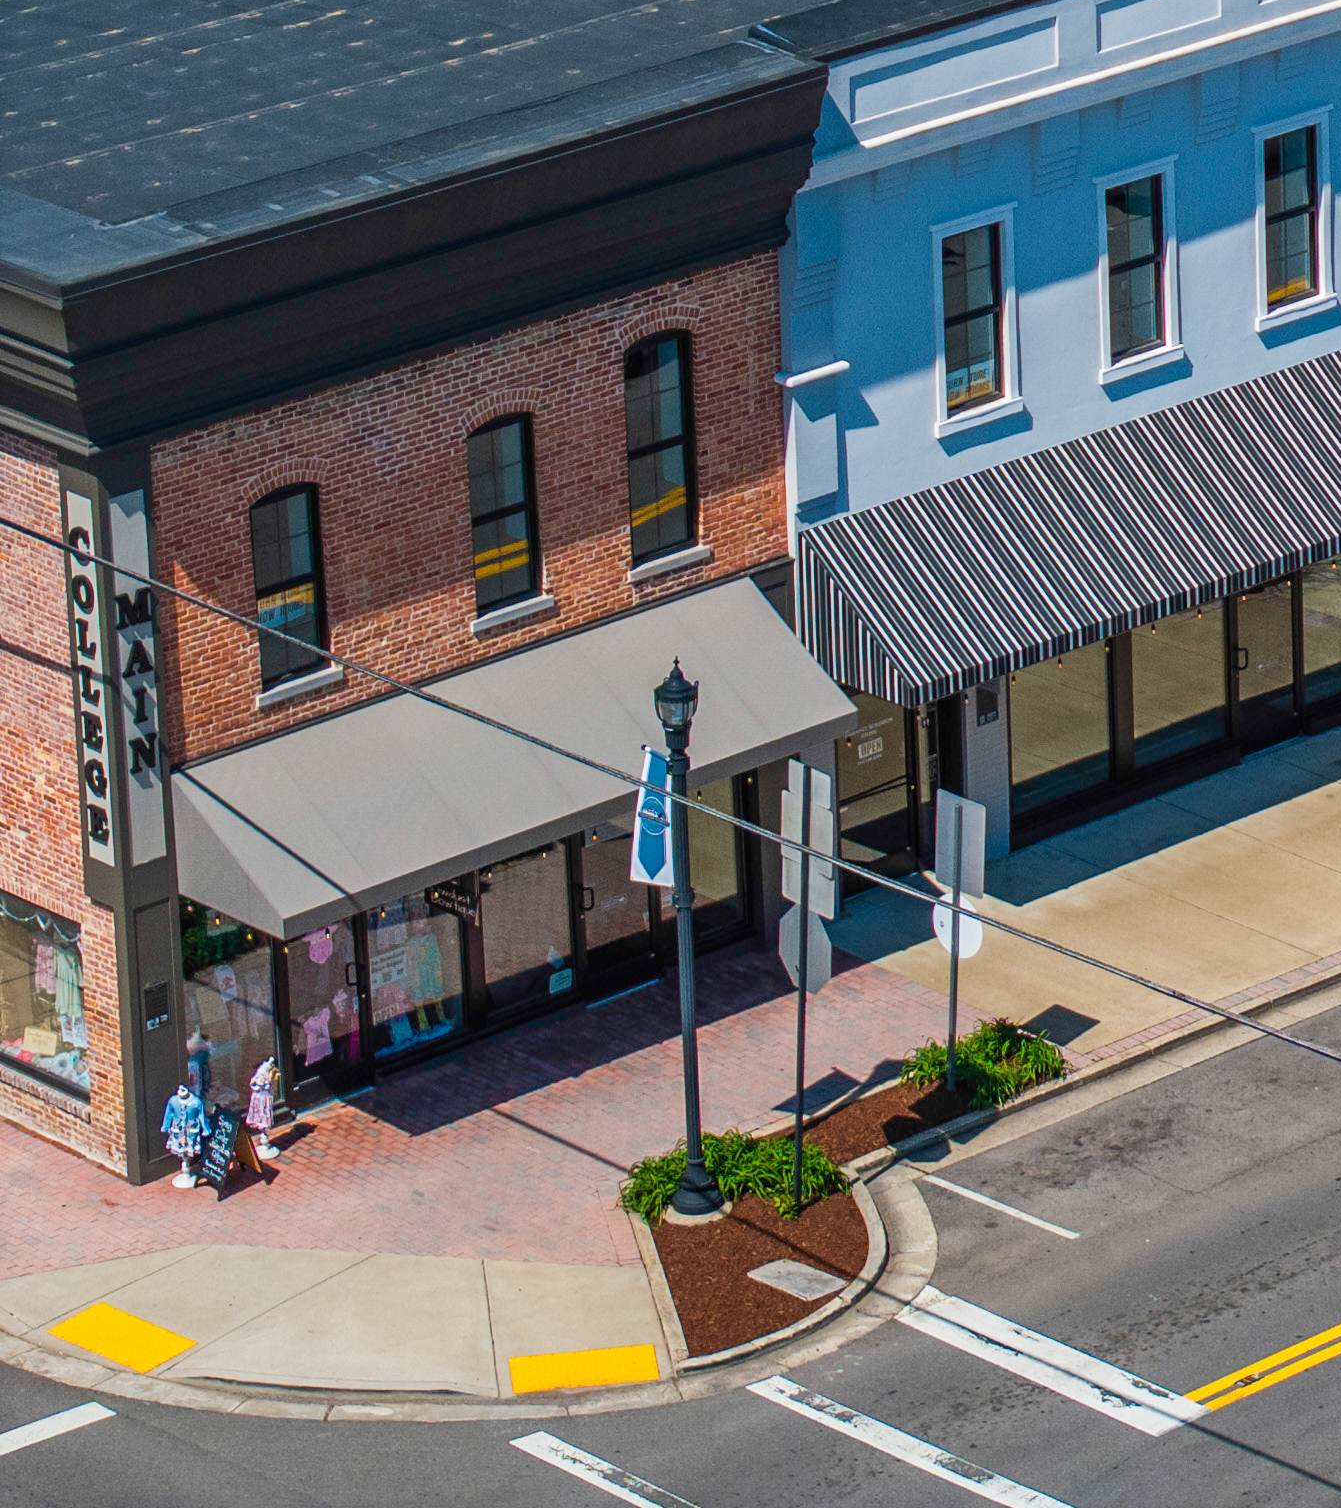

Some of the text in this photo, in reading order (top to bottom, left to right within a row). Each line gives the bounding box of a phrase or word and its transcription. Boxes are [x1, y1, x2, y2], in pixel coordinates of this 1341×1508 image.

[68, 525, 110, 846] COLLEGE
[114, 586, 157, 775] MAIN
[861, 739, 882, 757] OPEN
